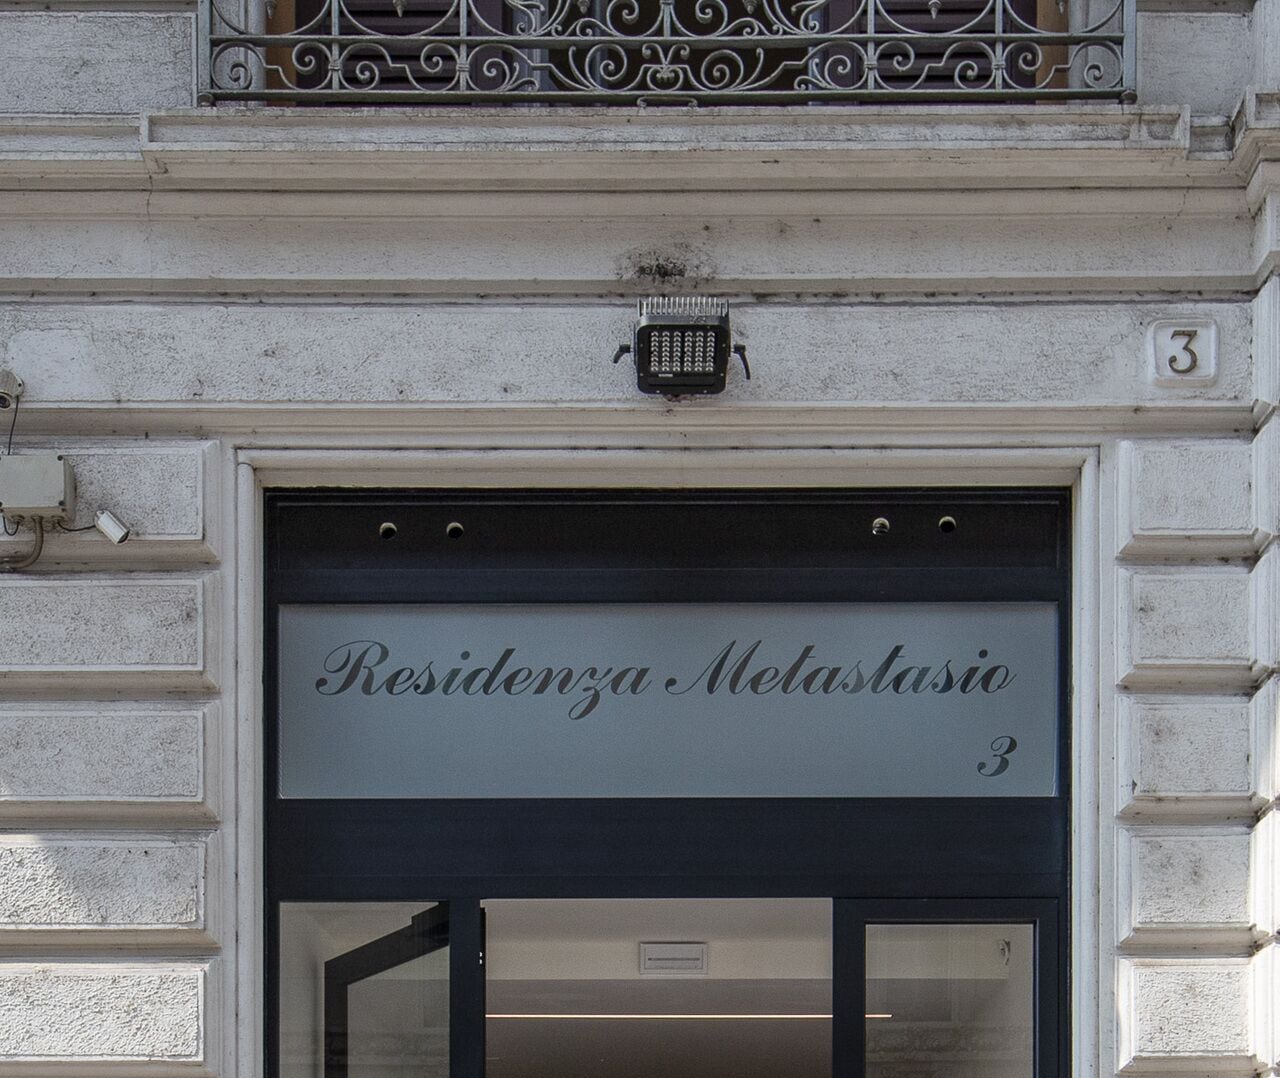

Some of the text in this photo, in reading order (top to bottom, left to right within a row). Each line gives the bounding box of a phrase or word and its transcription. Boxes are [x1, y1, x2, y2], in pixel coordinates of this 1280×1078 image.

[1168, 329, 1198, 375] 3
[315, 639, 1018, 721] Residenza Metastasio
[976, 735, 1018, 778] 3
